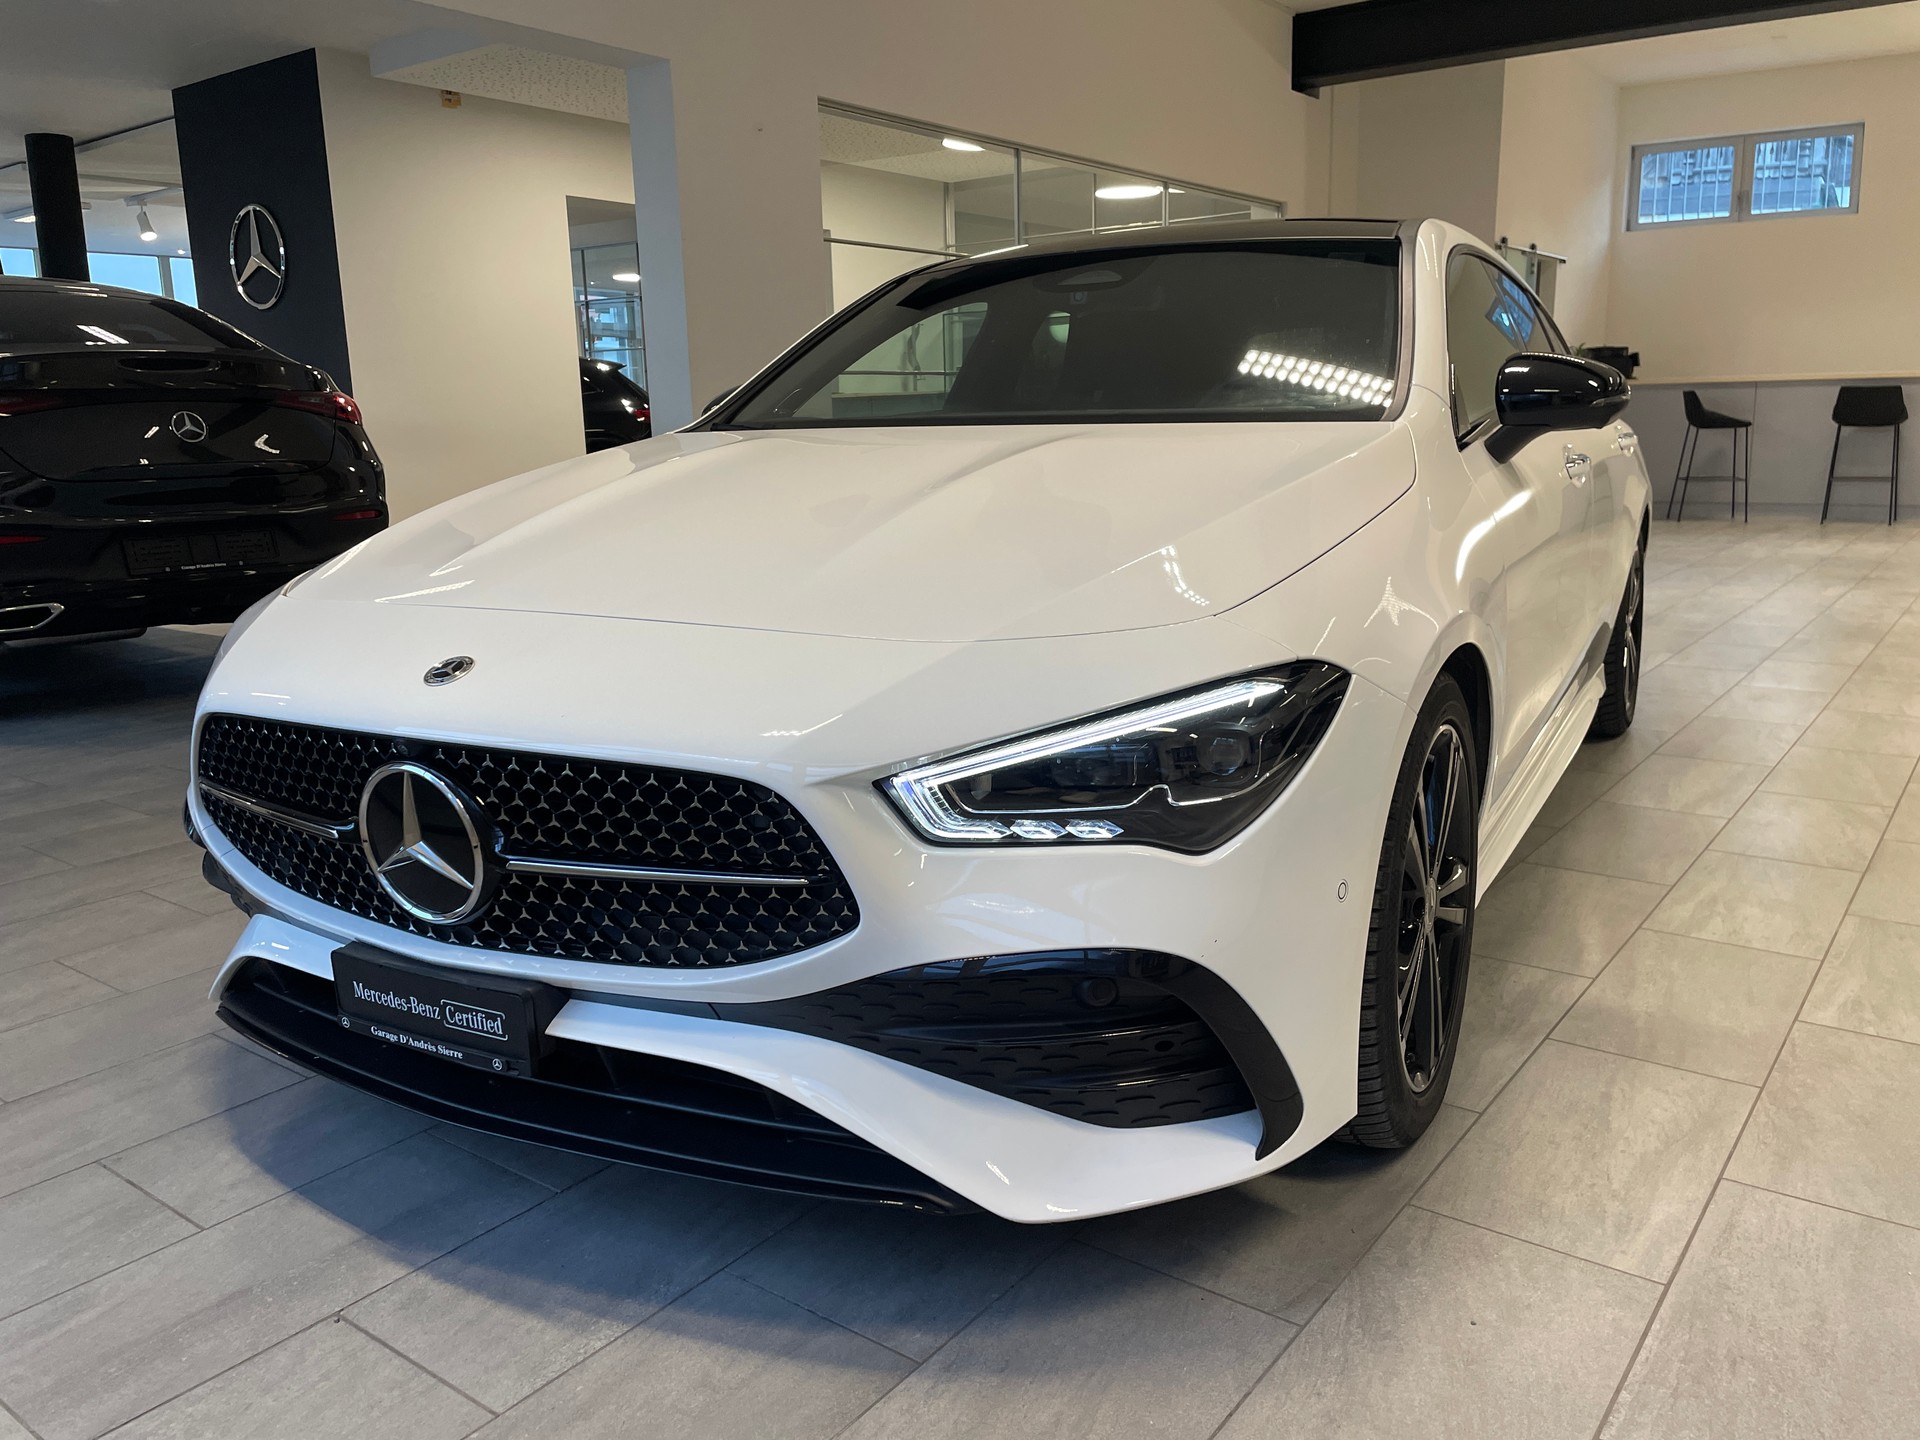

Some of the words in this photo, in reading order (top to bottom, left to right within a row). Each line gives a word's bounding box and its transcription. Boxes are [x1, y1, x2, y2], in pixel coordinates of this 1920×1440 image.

[353, 981, 440, 1020] Mercedes-Benz
[446, 1006, 503, 1035] Certified
[371, 1026, 398, 1042] Garage
[400, 1034, 437, 1052] D'Andrès
[437, 1044, 463, 1059] Sierre
